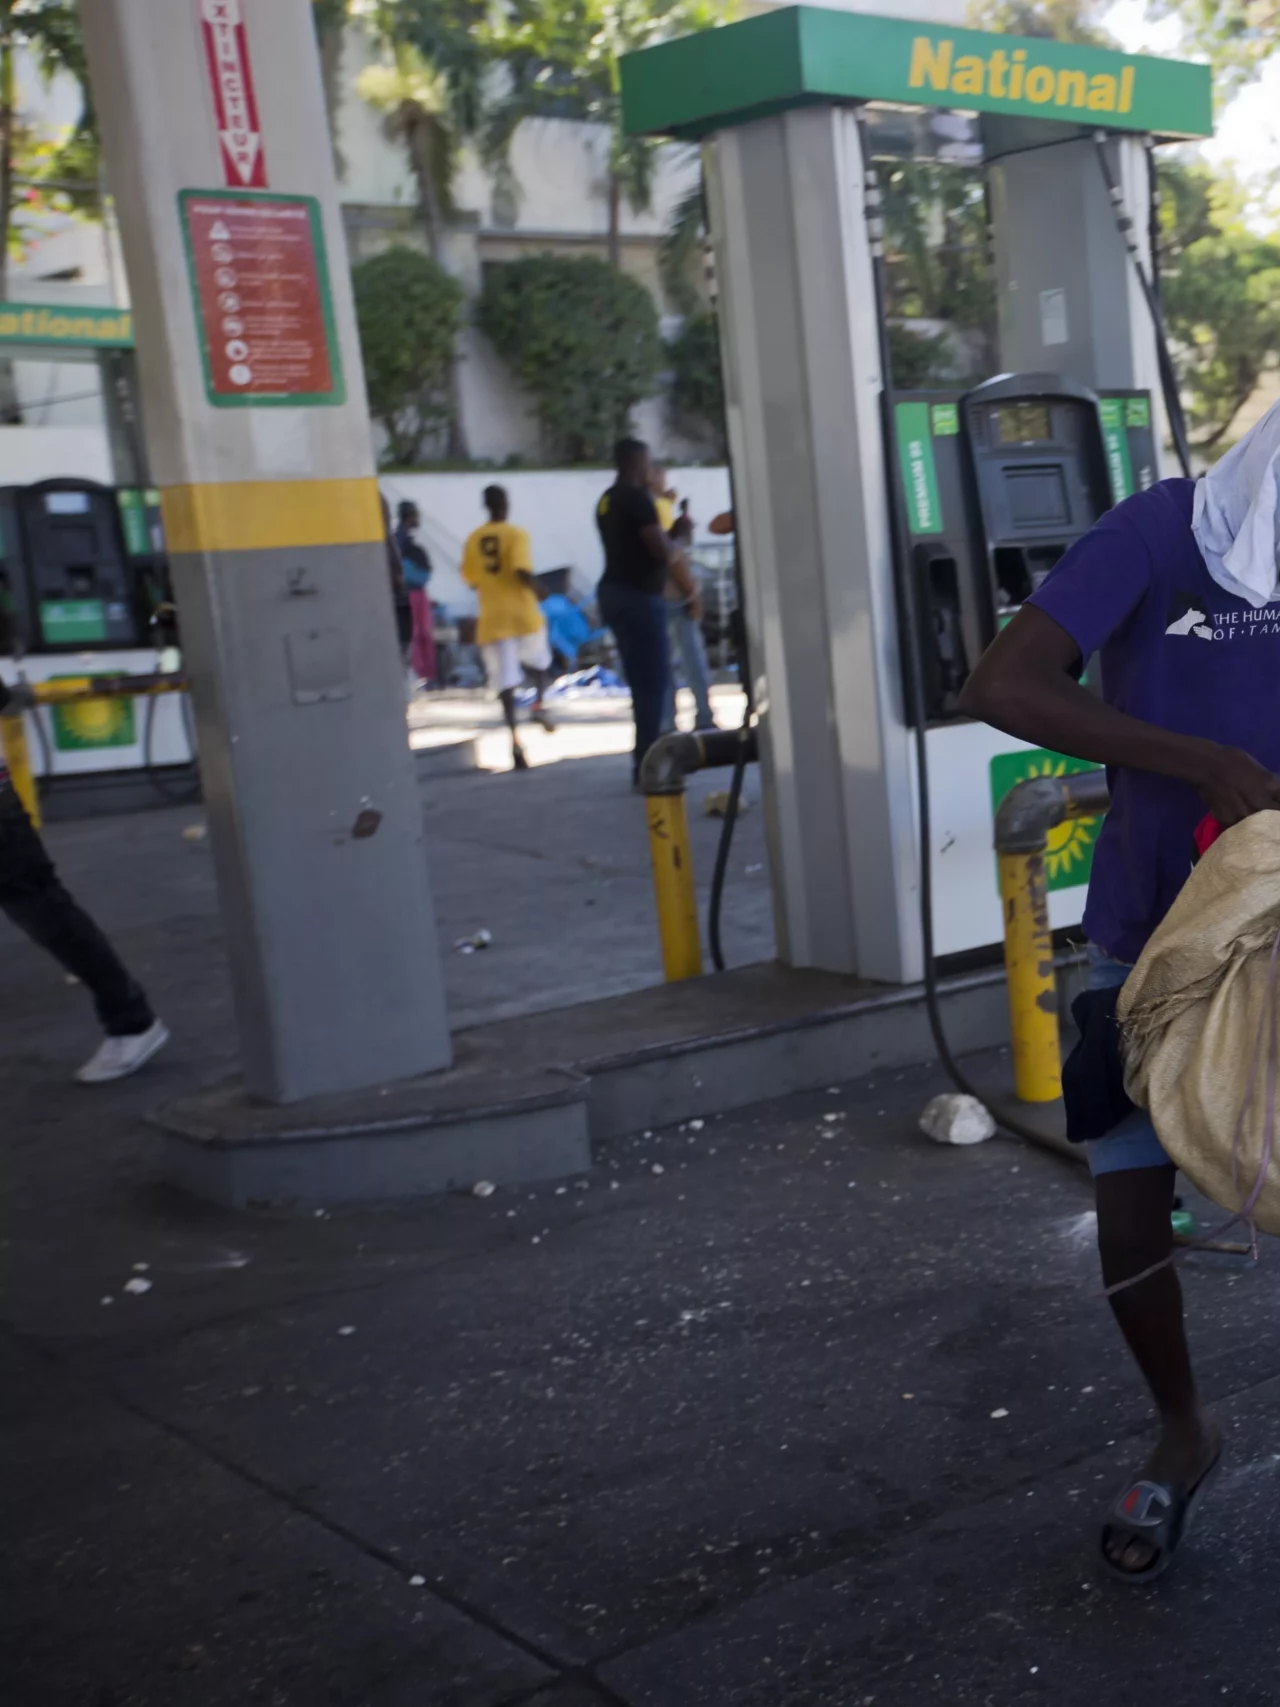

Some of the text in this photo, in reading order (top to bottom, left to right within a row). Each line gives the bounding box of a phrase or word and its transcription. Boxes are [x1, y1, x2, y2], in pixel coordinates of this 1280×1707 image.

[213, 0, 250, 161] XTINCTEUR
[908, 36, 1136, 113] National
[480, 536, 501, 573] 9
[1213, 611, 1239, 625] THE
[1213, 627, 1236, 640] OF
